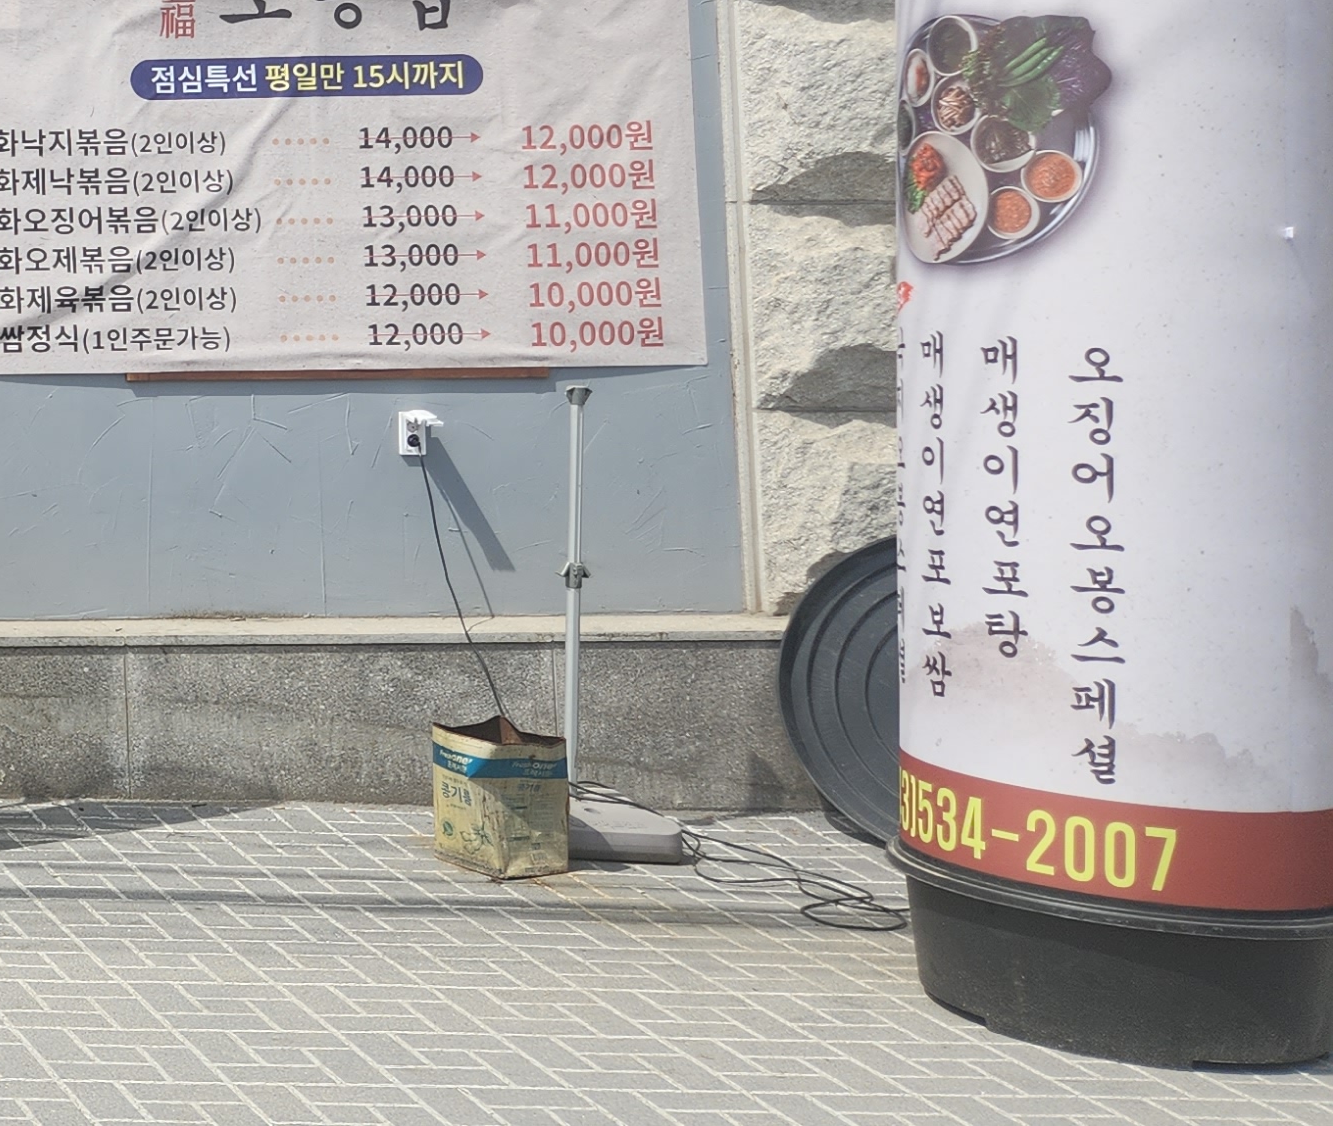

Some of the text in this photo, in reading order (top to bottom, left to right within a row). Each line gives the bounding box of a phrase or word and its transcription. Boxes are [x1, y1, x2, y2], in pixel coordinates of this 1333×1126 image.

[150, 60, 464, 95] 점심특선 평일만 15시까지
[358, 126, 453, 154] 14,000
[521, 120, 653, 155] 12,000원
[360, 165, 455, 193] 14,000
[523, 159, 655, 195] 12,000원
[362, 204, 457, 233] 13,000
[525, 198, 657, 234] 11,000원
[364, 244, 458, 272] 13,000
[527, 237, 659, 273] 11,000원
[366, 283, 460, 312] 12,000
[529, 277, 662, 313] 10,000원
[368, 322, 463, 351] 12,000
[531, 316, 664, 352] 10,000원
[920, 331, 952, 697] 매생이연포보쌈
[980, 336, 1028, 658] 매생이연포탕
[1067, 347, 1126, 785] 오징어오봉스페셜
[441, 780, 472, 807] 콩기름
